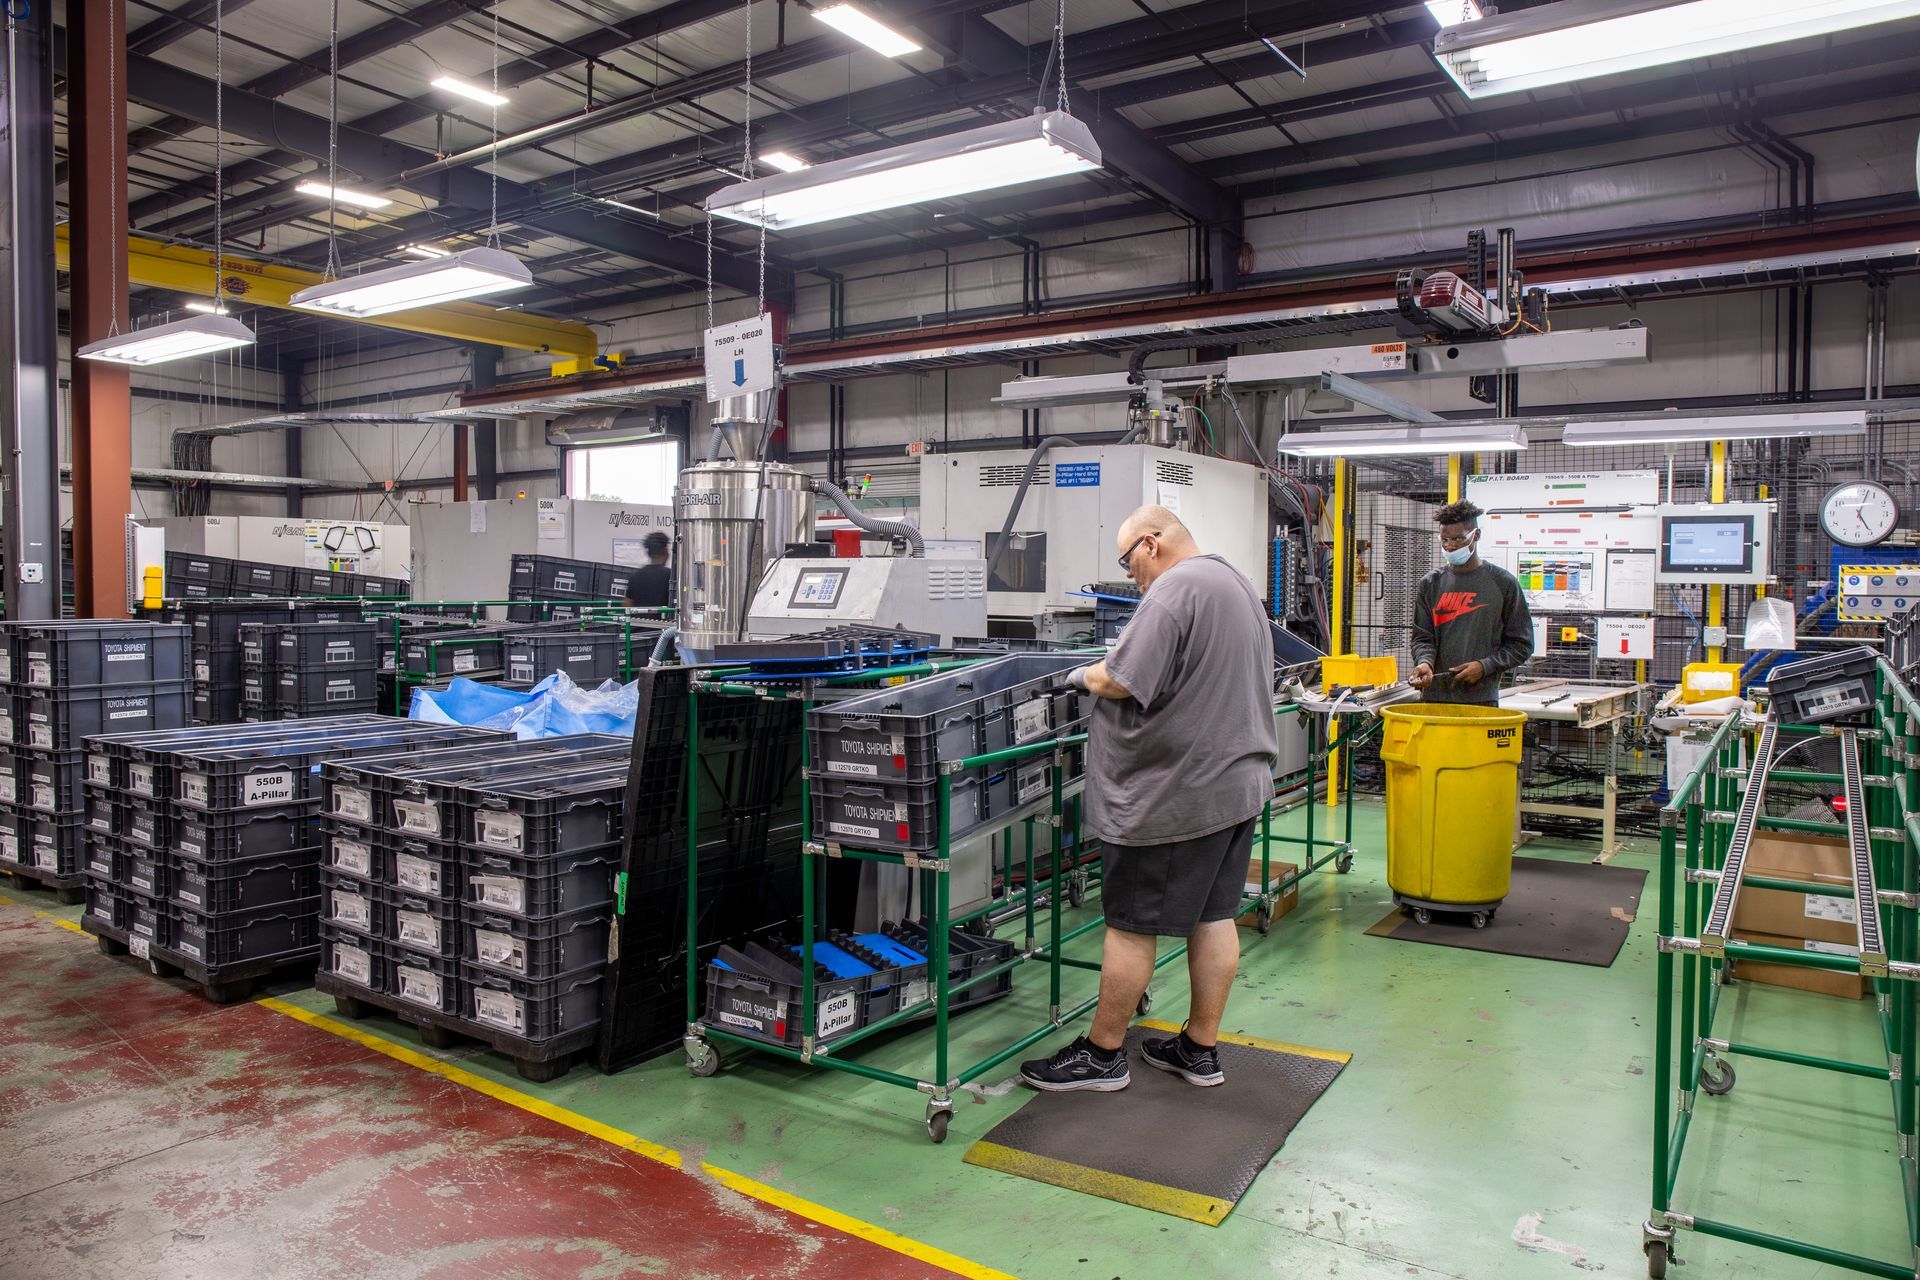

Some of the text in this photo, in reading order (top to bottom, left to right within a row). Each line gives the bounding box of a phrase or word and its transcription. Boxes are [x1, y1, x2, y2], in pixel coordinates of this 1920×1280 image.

[714, 336, 735, 347] 75509
[734, 348, 744, 356] LH
[1386, 344, 1402, 352] VOLTS
[540, 501, 553, 509] 500K
[685, 494, 721, 506] DRI-AIR
[1436, 592, 1477, 610] NIKE
[105, 643, 147, 653] TOYOTA SHIPMENT
[107, 698, 149, 709] TOYOTA SHIPMENT
[1488, 728, 1516, 738] BRUTE
[841, 740, 865, 754] TOYOTA
[256, 776, 283, 787] 550B
[250, 790, 289, 801] A-Pillar
[844, 804, 897, 822] TOYOTA SHIPMEN
[732, 999, 752, 1014] TOYOTA
[827, 999, 848, 1014] 550B
[822, 1014, 852, 1032] A-Pillar
